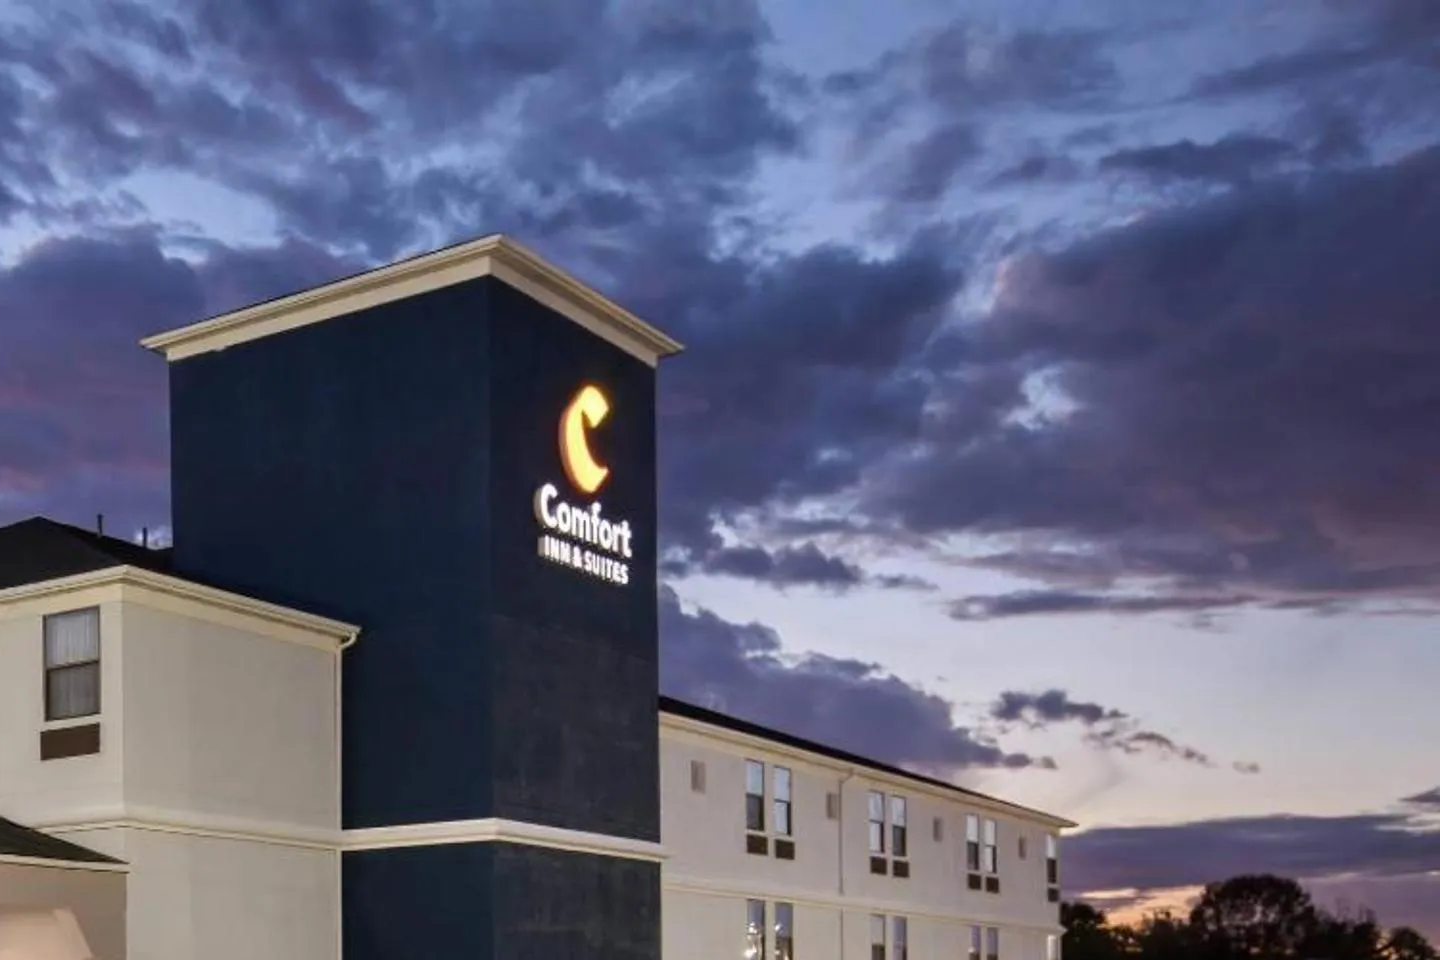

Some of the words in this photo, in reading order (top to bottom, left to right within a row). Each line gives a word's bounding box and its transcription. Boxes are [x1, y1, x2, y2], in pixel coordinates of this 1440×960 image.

[538, 483, 632, 558] Comfort
[543, 535, 571, 564] INN
[572, 546, 583, 568] &
[584, 550, 629, 584] SUITES
